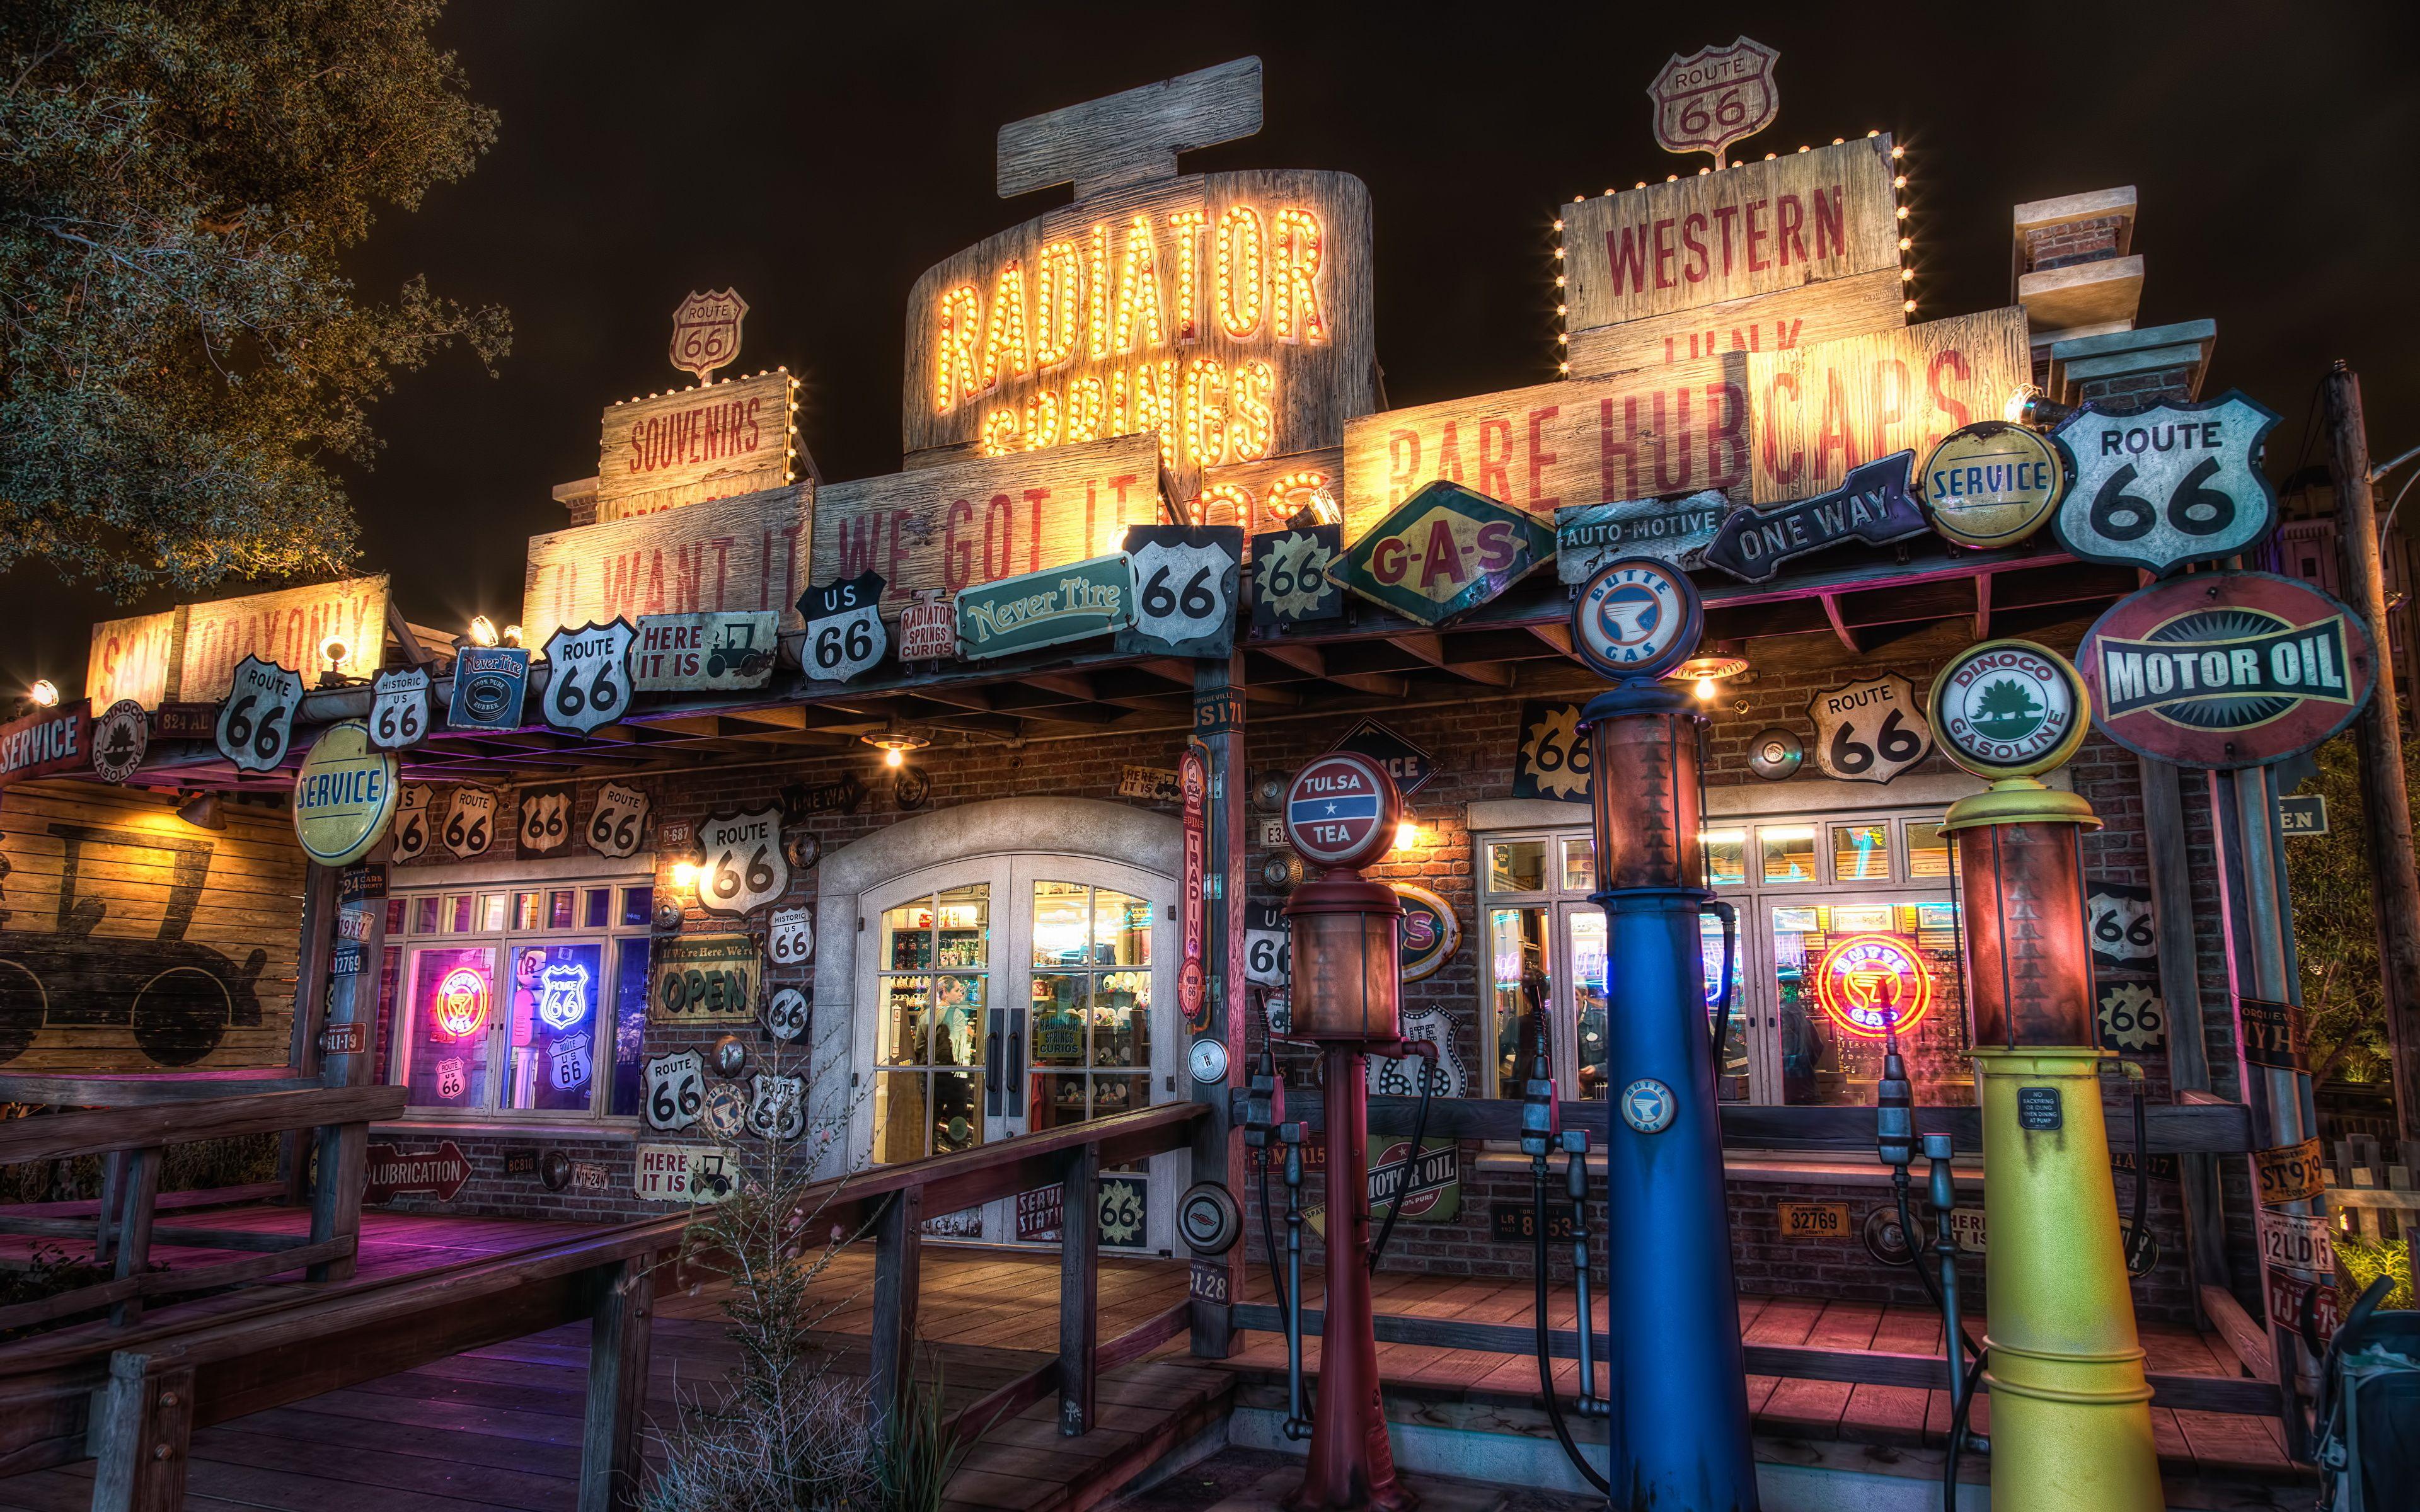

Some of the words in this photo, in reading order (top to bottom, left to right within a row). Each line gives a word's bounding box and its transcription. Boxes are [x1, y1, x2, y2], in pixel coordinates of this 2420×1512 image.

[1675, 59, 1745, 89] ROUTE
[1680, 88, 1746, 135] 66
[1605, 185, 1845, 297] WESTERN
[688, 304, 730, 319] ROUTE
[937, 204, 1334, 416] RADIATOR
[684, 328, 723, 358] 66
[629, 397, 761, 474] SOUVENIRS
[1388, 404, 1560, 512] RARE
[1600, 381, 1745, 503] HUB
[1763, 348, 1973, 488] CAPS
[2100, 421, 2223, 457] ROUTE
[1932, 461, 2048, 500] SERVICE
[2089, 455, 2237, 542] 66
[1566, 510, 1718, 547] AUTO-MOTIVE
[1739, 513, 1809, 562] ONE
[1812, 485, 1891, 536] WAY
[602, 536, 735, 624] WANT
[759, 524, 805, 615] IT
[839, 509, 913, 601] WE
[943, 488, 1052, 593] GOT
[1083, 474, 1139, 556] IT
[1268, 550, 1324, 599] 66
[1589, 569, 1671, 602] BUTTE
[824, 584, 856, 612] US
[1141, 564, 1218, 620] 66
[902, 605, 953, 631] RADIATOR
[968, 590, 1057, 643] Never
[1059, 576, 1121, 616] Tire
[562, 637, 615, 661] ROUTE
[642, 625, 703, 651] HERE
[815, 619, 873, 670] 66
[902, 642, 953, 658] CURIOS
[909, 627, 947, 645] SPRINGS
[464, 655, 498, 675] Never
[500, 654, 523, 675] Tire
[1605, 641, 1656, 662] GAS
[639, 653, 665, 680] IT
[673, 652, 701, 678] IS
[1953, 653, 2054, 690] DINOCO
[2105, 647, 2261, 704] MOTOR
[2269, 633, 2343, 690] OIL
[248, 668, 292, 698] ROUTE
[382, 677, 422, 690] HISTORIC
[474, 679, 489, 688] 100%
[490, 679, 505, 690] PURE
[556, 659, 618, 718] 66
[473, 701, 500, 711] RUBBER
[1827, 684, 1894, 715] ROUTE
[101, 701, 145, 727] DINOCO
[163, 713, 187, 731] 824
[225, 694, 286, 760] 66
[379, 703, 418, 740] 66
[0, 715, 78, 775] SERVICE
[1830, 707, 1922, 775] 66
[1950, 708, 2066, 760] GASOLINE
[95, 745, 145, 781] GASOLINE
[1535, 728, 1591, 774] 66
[297, 769, 382, 810] SERVICE
[1124, 781, 1136, 791] IT
[1140, 783, 1153, 794] IS
[1126, 769, 1156, 782] HERE
[1304, 774, 1362, 793] TULSA
[459, 793, 490, 810] ROUTE
[606, 790, 641, 810] ROUTE
[825, 785, 855, 807] WAY
[446, 810, 493, 854] 66
[526, 806, 565, 839] 66
[591, 806, 637, 849] 66
[716, 822, 769, 847] ROUTE
[1187, 817, 1200, 827] PIN
[1313, 824, 1351, 844] TEA
[343, 876, 360, 895] 24
[712, 843, 775, 900] 66
[1188, 833, 1200, 954] TRADING
[774, 912, 807, 924] HISTORIC
[2094, 908, 2155, 943] 66
[672, 946, 698, 958] We're
[700, 946, 725, 958] Here,
[726, 945, 754, 957] We're
[775, 933, 807, 959] 66
[1833, 946, 1910, 974] BUTTE
[550, 980, 579, 992] ROUTE
[660, 966, 749, 1014] OPEN
[1188, 986, 1196, 997] 66
[548, 990, 580, 1019] 66
[771, 999, 807, 1029] 66
[2111, 999, 2160, 1033] 66
[1040, 1016, 1079, 1033] RADIATOR
[1046, 1031, 1074, 1044] SPRINGS
[559, 1040, 577, 1053] ROUTE
[1040, 1044, 1080, 1054] CURIOS
[441, 1062, 459, 1072] ROUTE
[561, 1060, 582, 1085] 66
[654, 1057, 693, 1077] ROUTE
[442, 1078, 460, 1095] 66
[652, 1074, 702, 1123] 66
[760, 1081, 795, 1097] ROUTE
[1625, 1081, 1668, 1097] BUTTE
[754, 1096, 795, 1132] 66
[1634, 1121, 1660, 1131] GAS
[371, 1160, 461, 1186] LUBRICATION
[509, 1158, 534, 1172] BC810
[643, 1152, 688, 1172] HERE
[642, 1174, 660, 1192] IT
[666, 1174, 687, 1193] IS
[1368, 1162, 1420, 1199] MOTOR
[1426, 1155, 1455, 1184] OIL
[1102, 1195, 1136, 1228] 66
[1306, 1207, 1325, 1220] SPAR
[1400, 1198, 1415, 1208] 00%
[1414, 1193, 1434, 1205] PURE
[1501, 1214, 1516, 1224] LR
[1791, 1212, 1838, 1230] 32769
